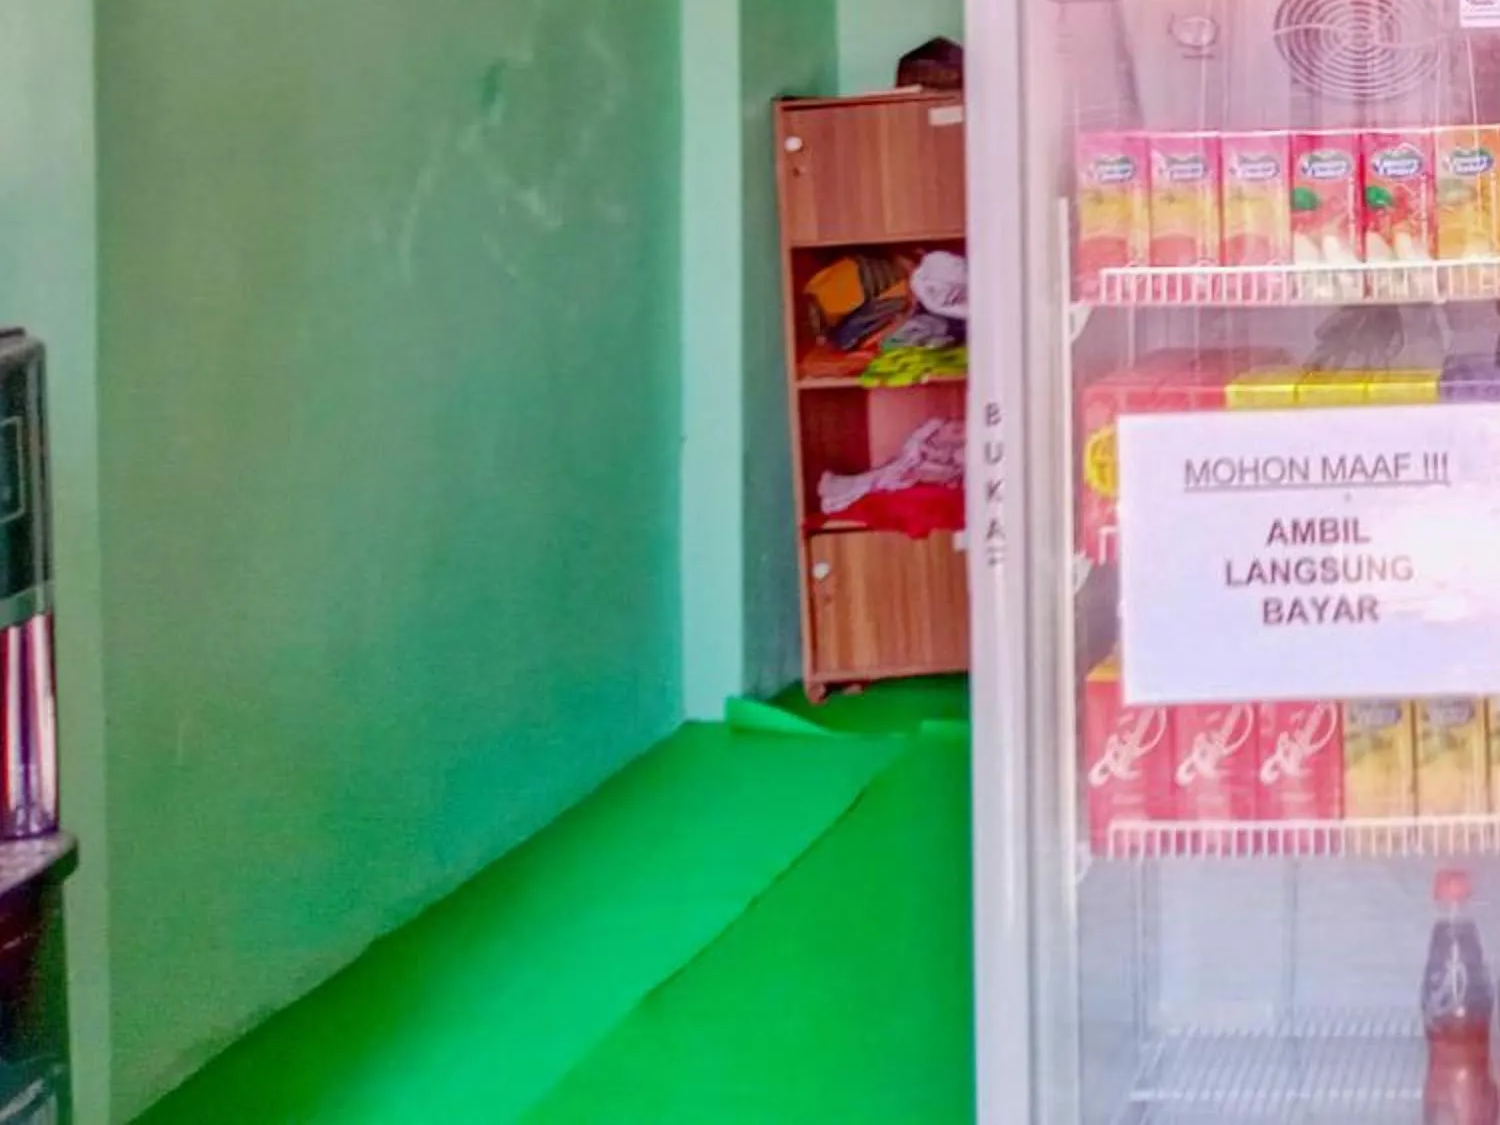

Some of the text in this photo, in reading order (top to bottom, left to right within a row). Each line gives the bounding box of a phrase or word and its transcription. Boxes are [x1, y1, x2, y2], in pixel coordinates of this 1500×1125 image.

[1184, 451, 1449, 487] MOHON MAAF !!!
[1265, 516, 1372, 547] AMBIL
[1224, 554, 1415, 587] LANGSUNG
[1262, 593, 1380, 627] BAYAR
